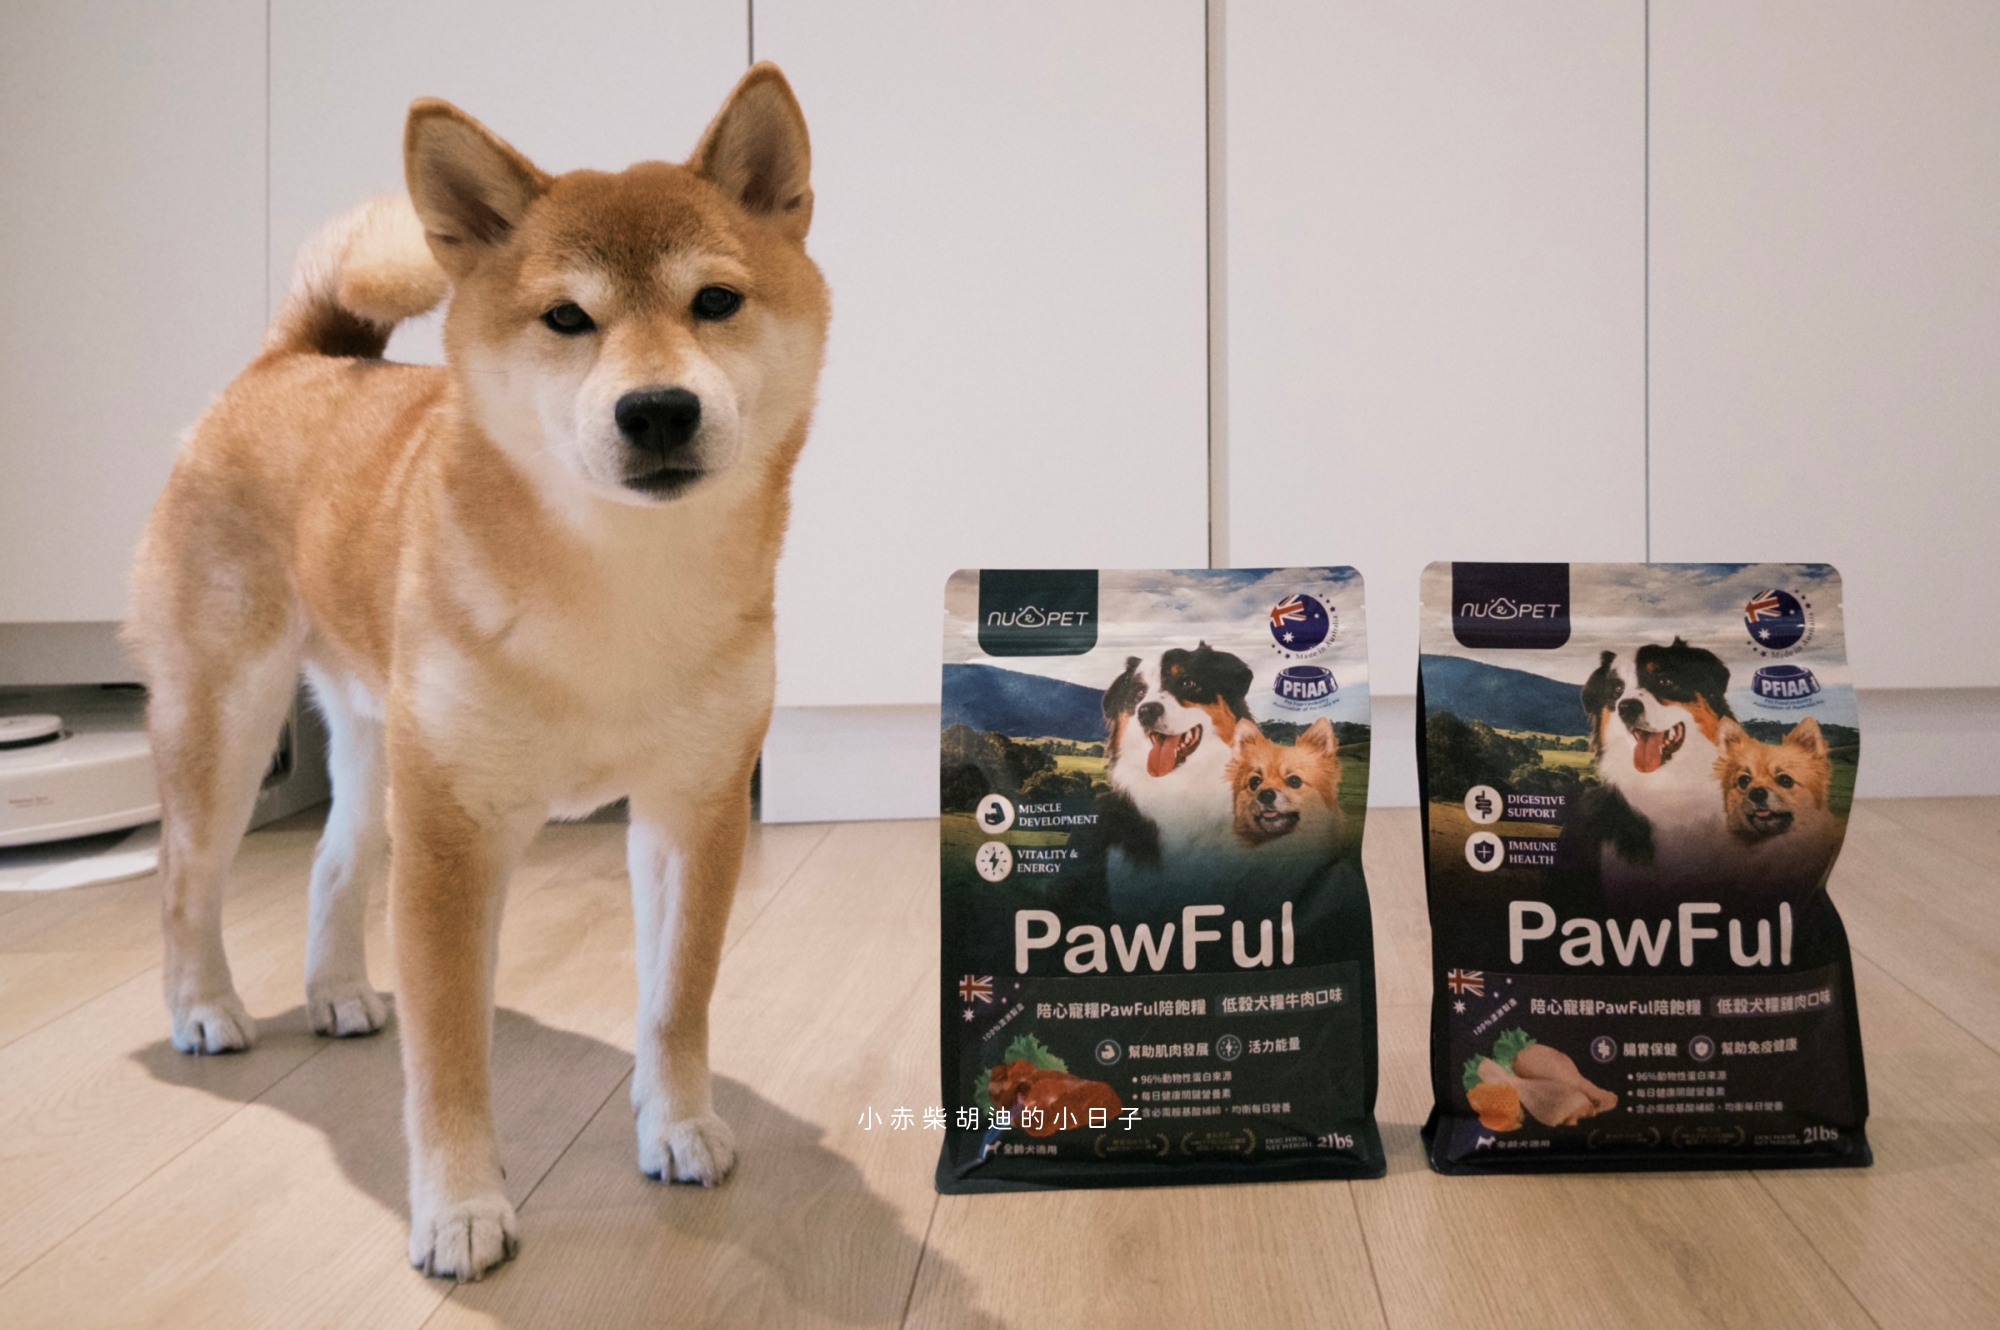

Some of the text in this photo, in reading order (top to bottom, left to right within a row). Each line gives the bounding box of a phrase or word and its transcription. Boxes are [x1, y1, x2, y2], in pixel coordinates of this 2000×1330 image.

[1295, 652, 1317, 660] Made
[1326, 615, 1339, 647] Australia
[1282, 680, 1328, 698] PFIAA
[1761, 678, 1810, 697] PFIAA
[1507, 794, 1566, 805] DIGESTIVE
[1018, 803, 1062, 814] MUSCLE
[1507, 808, 1557, 818] SUPPORT
[1018, 814, 1099, 827] DEVELOPMENT
[1017, 849, 1079, 860] VITALITY &
[1508, 841, 1557, 852] IMMUNE
[1017, 863, 1061, 873] ENERGY
[1509, 854, 1554, 865] HEALTH
[1015, 901, 1295, 974] PawFul
[1509, 900, 1793, 967] PawFul
[1036, 987, 1344, 1019] 陪心寵糧PawFul陪飽糧 低穀犬糧牛肉口味
[1530, 999, 1701, 1016] 陪心寵糧PawFul陪飽糧
[1128, 1036, 1301, 1059] 幫助肌肉發展 活力能量
[1622, 1037, 1798, 1057] 腸胃保健 幫助免疫健康
[1317, 1132, 1354, 1149] 2lbs
[1803, 1125, 1839, 1144] 2lbs
